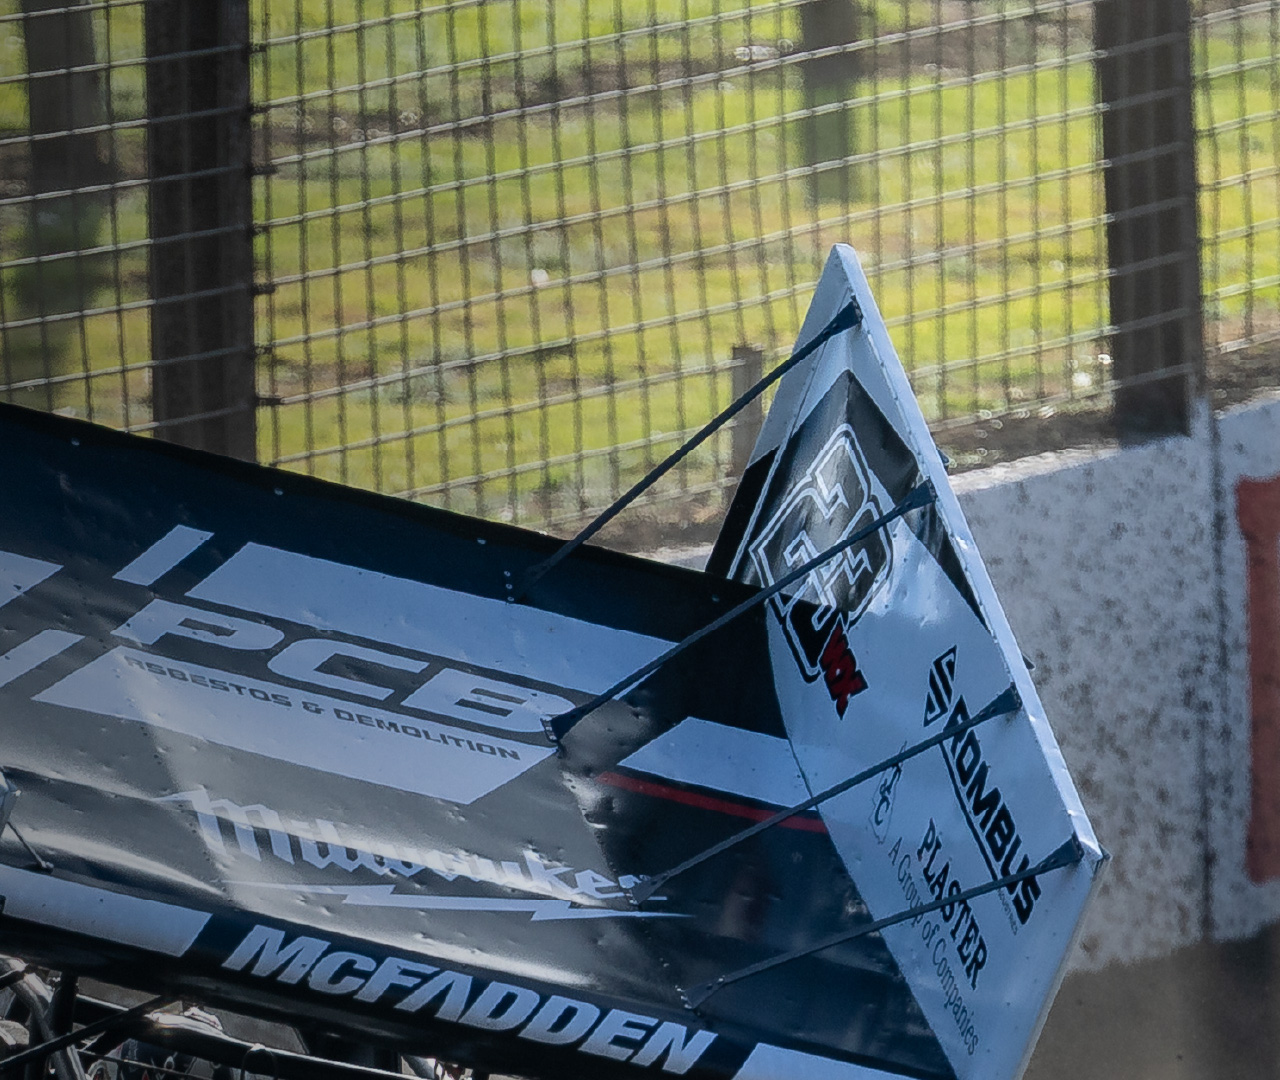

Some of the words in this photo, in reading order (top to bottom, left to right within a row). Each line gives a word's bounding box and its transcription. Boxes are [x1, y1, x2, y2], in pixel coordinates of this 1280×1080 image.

[111, 597, 578, 732] PCB
[123, 654, 295, 710] ASBESTOS
[301, 698, 326, 716] &
[333, 708, 522, 761] DEMOLITION
[942, 694, 1042, 925] ROMBUS
[888, 836, 902, 866] A
[921, 921, 940, 949] of
[932, 938, 980, 1056] Companies
[917, 817, 989, 990] PLASTER
